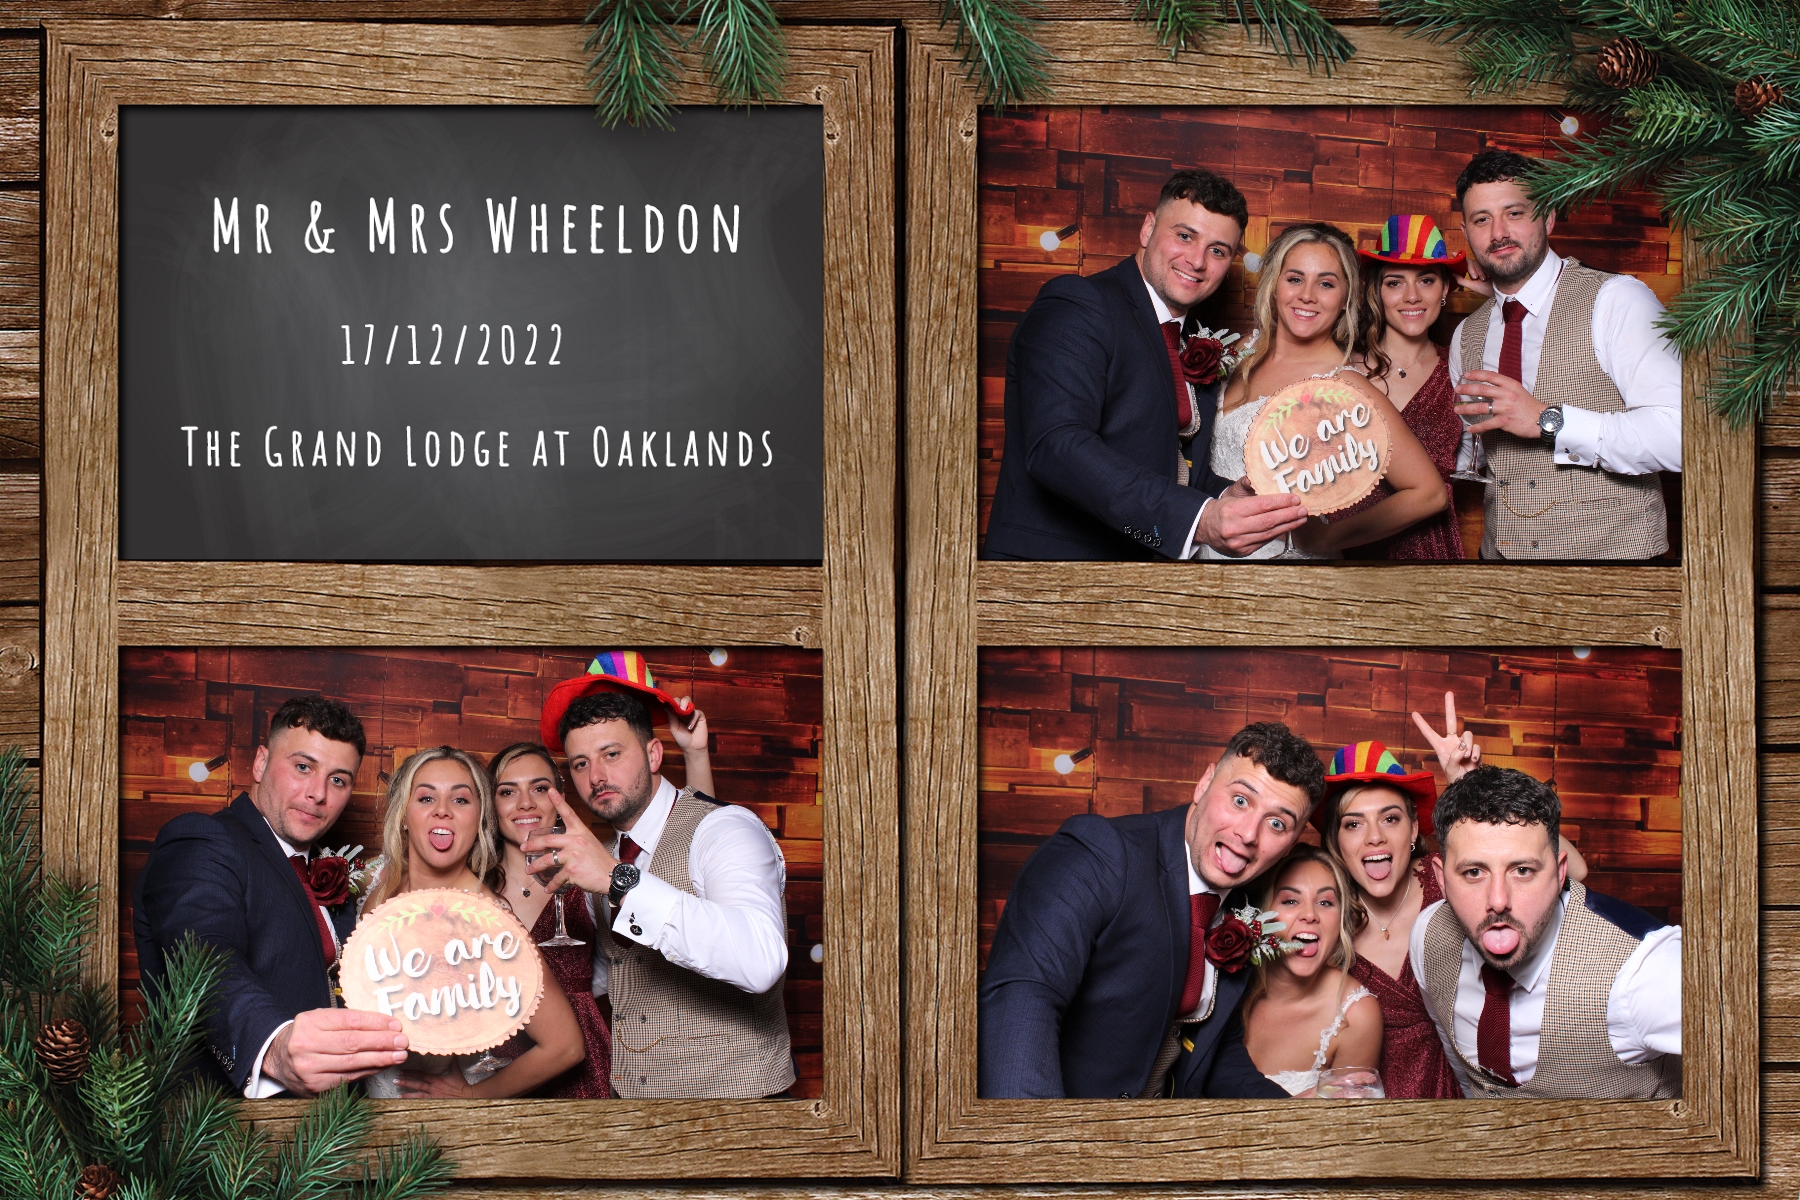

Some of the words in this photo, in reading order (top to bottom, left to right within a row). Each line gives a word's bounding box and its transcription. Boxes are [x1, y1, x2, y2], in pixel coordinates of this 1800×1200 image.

[1259, 425, 1310, 470] We
[1317, 403, 1371, 442] are
[1273, 432, 1378, 494] Family
[364, 931, 432, 982] We
[444, 930, 520, 966] are
[372, 961, 522, 1021] Family
